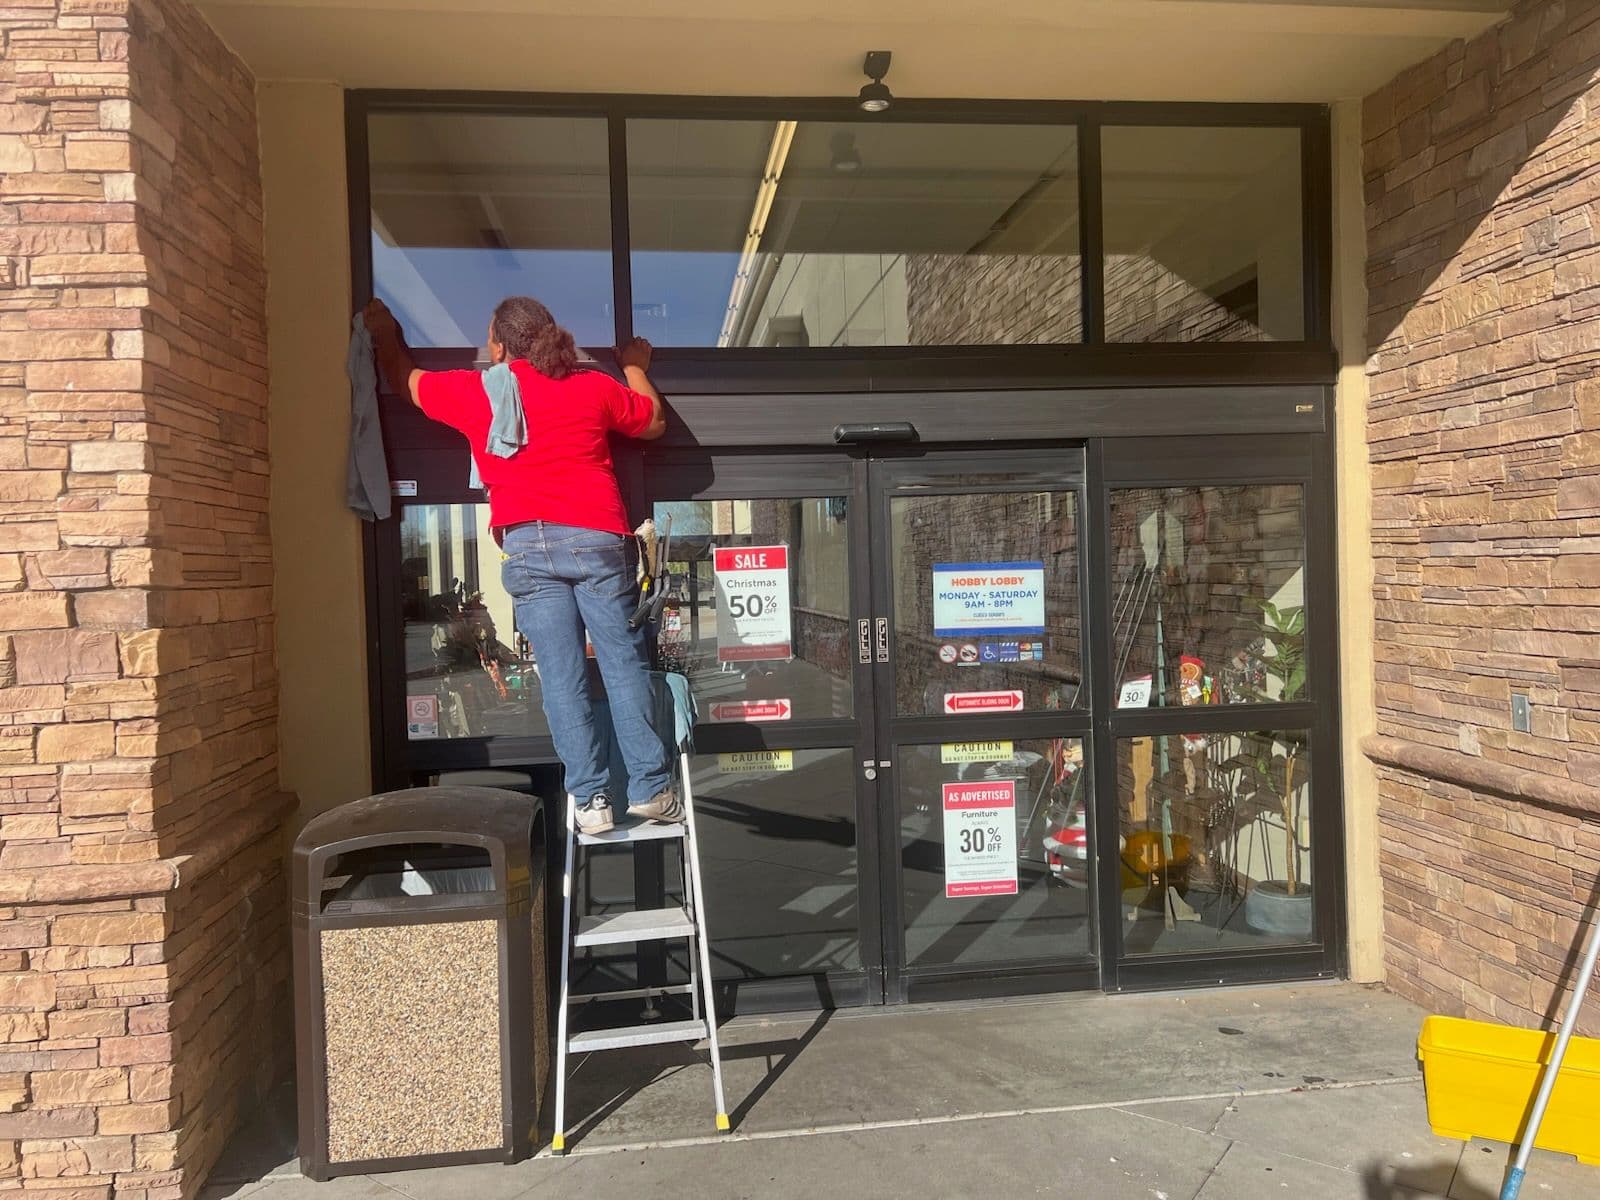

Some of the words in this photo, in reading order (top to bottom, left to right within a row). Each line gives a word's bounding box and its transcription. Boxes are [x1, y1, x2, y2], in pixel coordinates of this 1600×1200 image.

[735, 553, 767, 569] SALE
[726, 579, 777, 588] Christmas
[951, 577, 988, 587] HOBBY
[990, 576, 1025, 586] LOBBY
[939, 591, 981, 600] MONDAY
[989, 590, 1038, 599] SATURDAY
[964, 600, 985, 608] 9AM
[993, 600, 1013, 608] 8PM
[954, 742, 1001, 752] CAUTION
[731, 752, 780, 762] CAUTION
[948, 792, 959, 803] AS
[960, 790, 1011, 802] ADVERTISED
[987, 843, 1002, 852] OFF
